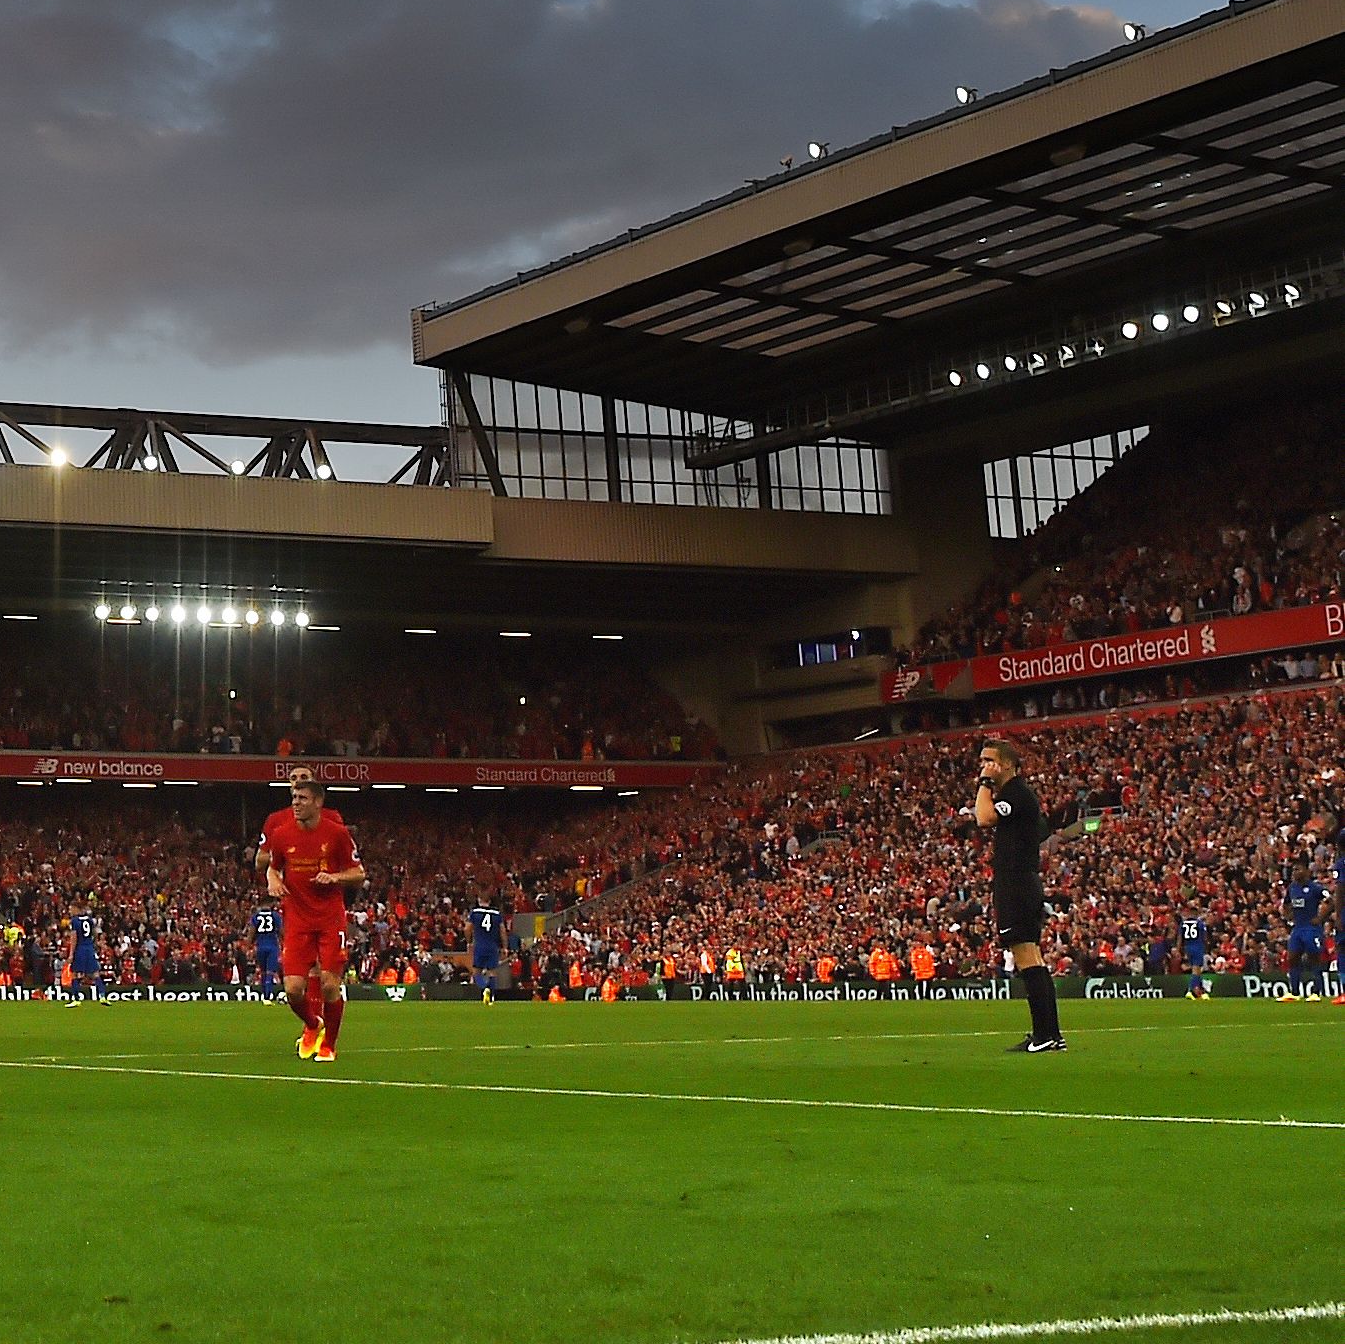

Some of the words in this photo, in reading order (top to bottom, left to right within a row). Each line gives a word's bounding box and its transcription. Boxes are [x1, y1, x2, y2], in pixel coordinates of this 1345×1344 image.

[999, 647, 1084, 682] Standard
[1090, 630, 1190, 669] Chartered
[64, 761, 94, 774] new
[99, 760, 163, 776] balance
[476, 767, 537, 782] Standard
[541, 767, 607, 783] Chartered
[82, 920, 90, 937] 9
[256, 916, 273, 932] 23
[481, 914, 492, 932] 4
[1182, 922, 1198, 939] 26
[890, 982, 909, 1000] in
